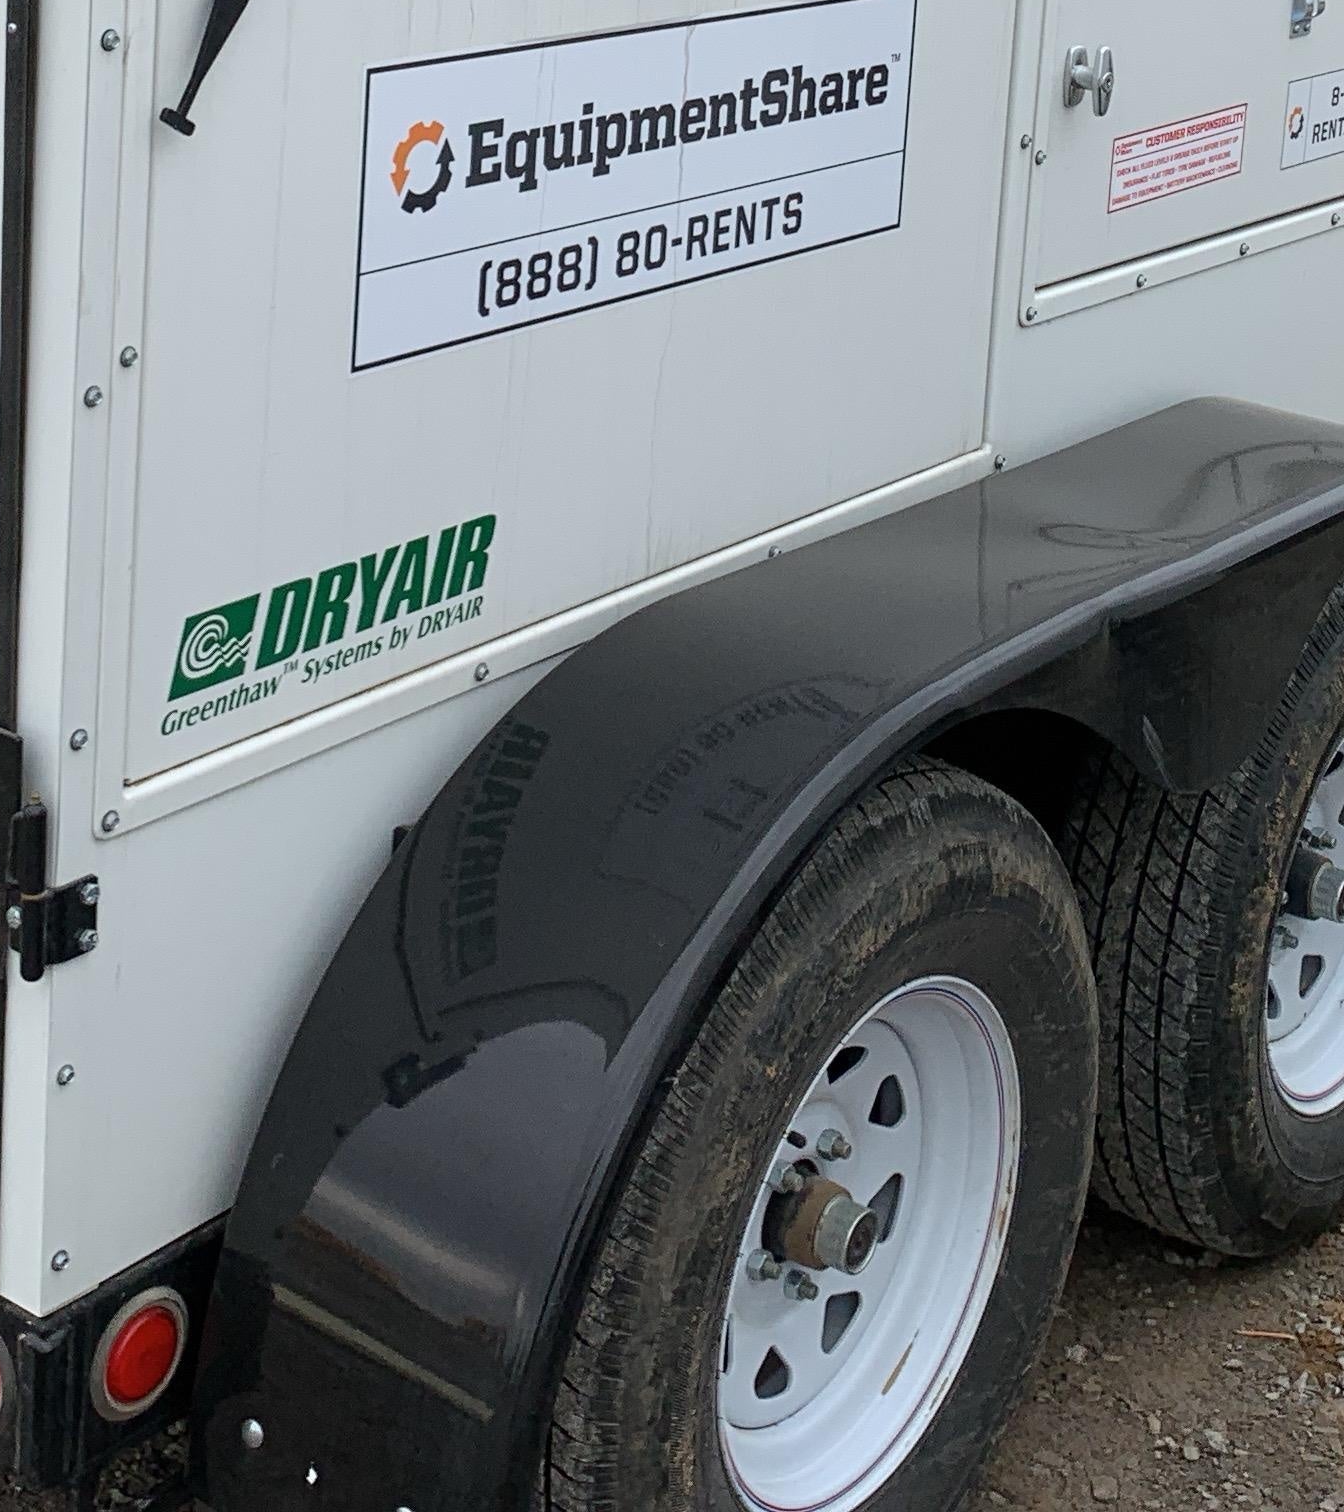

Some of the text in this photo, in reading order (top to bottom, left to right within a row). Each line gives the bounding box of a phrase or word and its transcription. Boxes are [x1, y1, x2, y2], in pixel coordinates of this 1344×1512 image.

[477, 191, 804, 317] (888) 80-RENTS
[254, 513, 498, 671] DRYAIR
[160, 674, 283, 737] Greenthaw
[301, 635, 384, 684] Systems
[388, 624, 414, 650] by
[416, 595, 484, 640] DRYAIR
